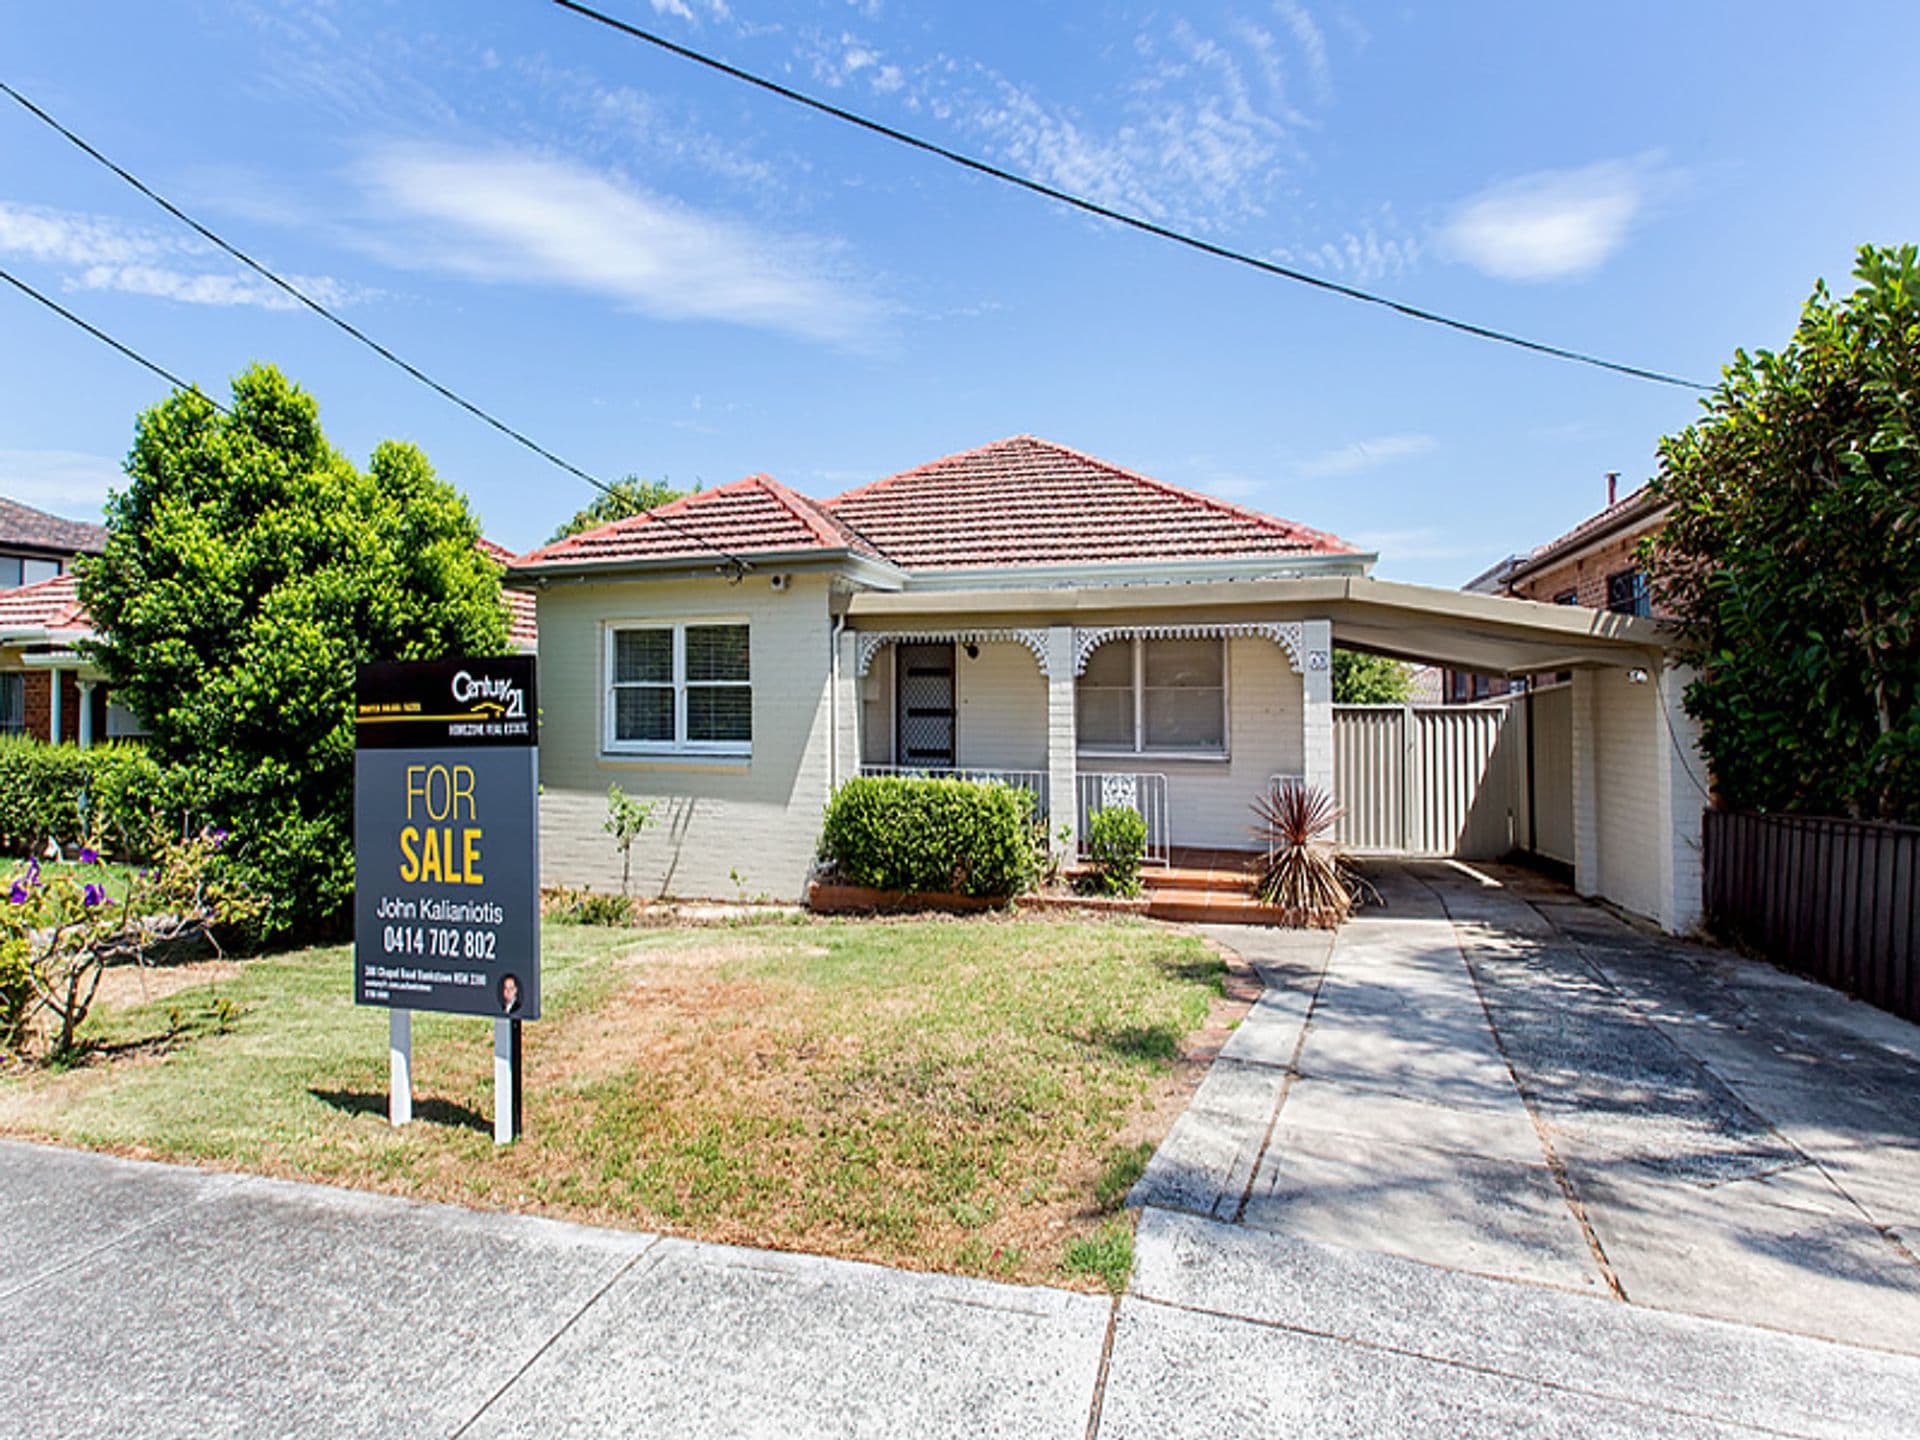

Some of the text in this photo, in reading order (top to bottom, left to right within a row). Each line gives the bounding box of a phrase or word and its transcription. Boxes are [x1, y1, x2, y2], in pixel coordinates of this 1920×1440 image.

[451, 670, 527, 718] Century 21
[406, 764, 476, 821] FOR
[400, 826, 484, 884] SALE
[376, 896, 503, 924] John Kalianiotis
[383, 926, 496, 960] 0414 702 802
